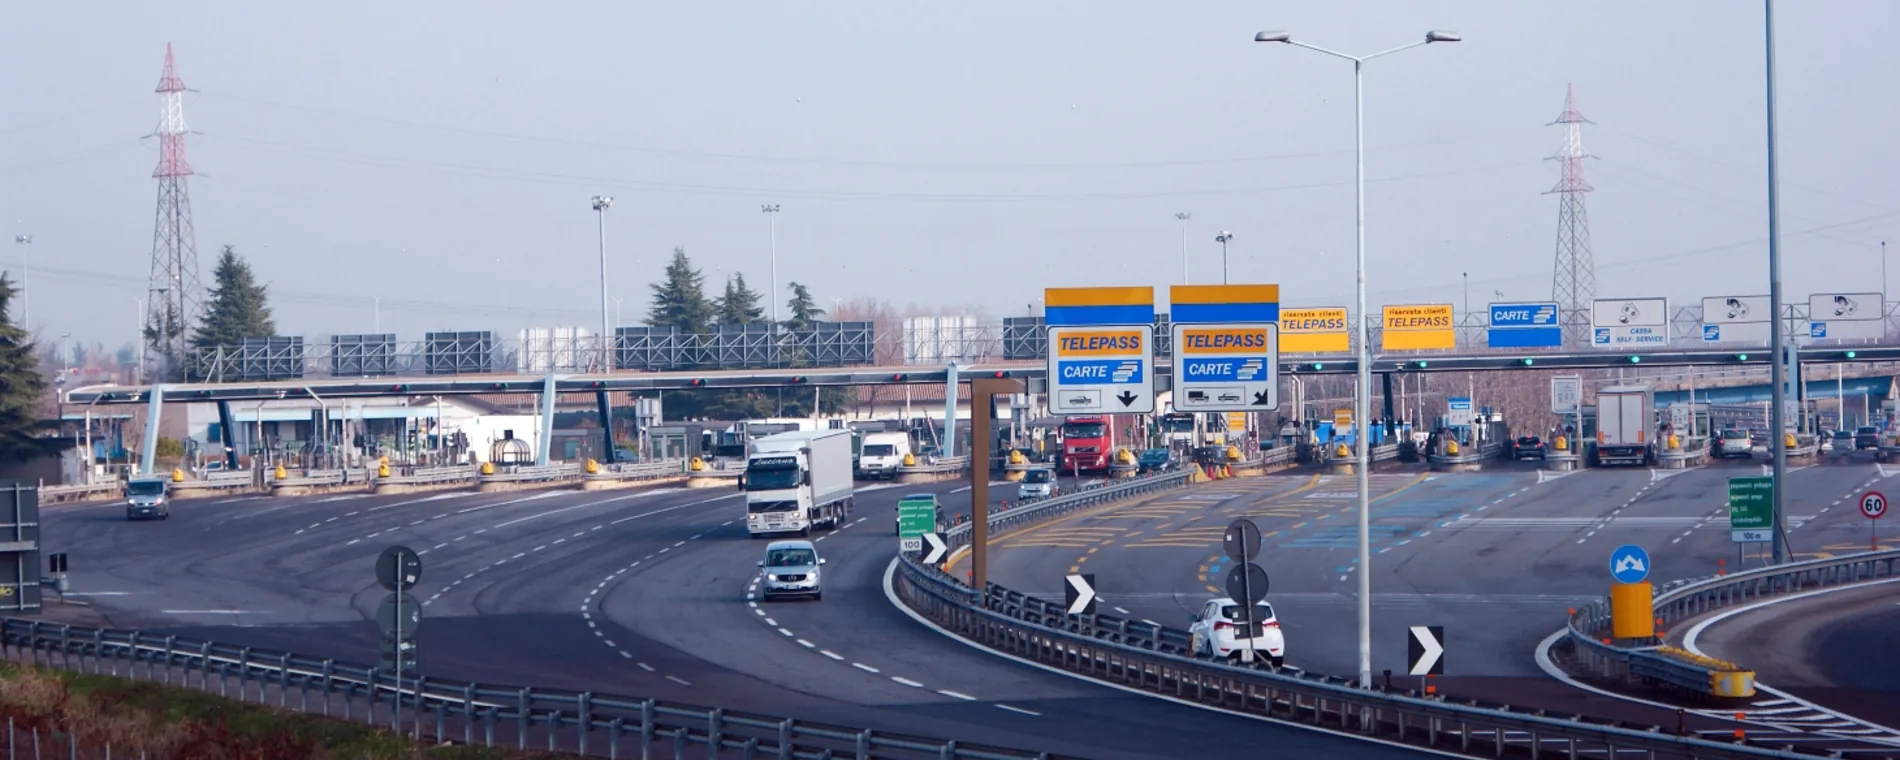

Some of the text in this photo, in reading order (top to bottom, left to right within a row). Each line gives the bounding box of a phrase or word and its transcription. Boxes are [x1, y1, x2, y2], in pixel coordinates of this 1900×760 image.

[1387, 316, 1449, 327] TELEPASS
[1494, 310, 1530, 321] CARTE
[1282, 318, 1344, 329] TELEPASS
[1060, 335, 1140, 350] TELEPASS
[1186, 333, 1265, 348] TELEPASS
[1063, 365, 1108, 379] CARTE
[1188, 363, 1232, 376] CARTE
[1865, 498, 1882, 512] 60
[904, 541, 920, 549] 100
